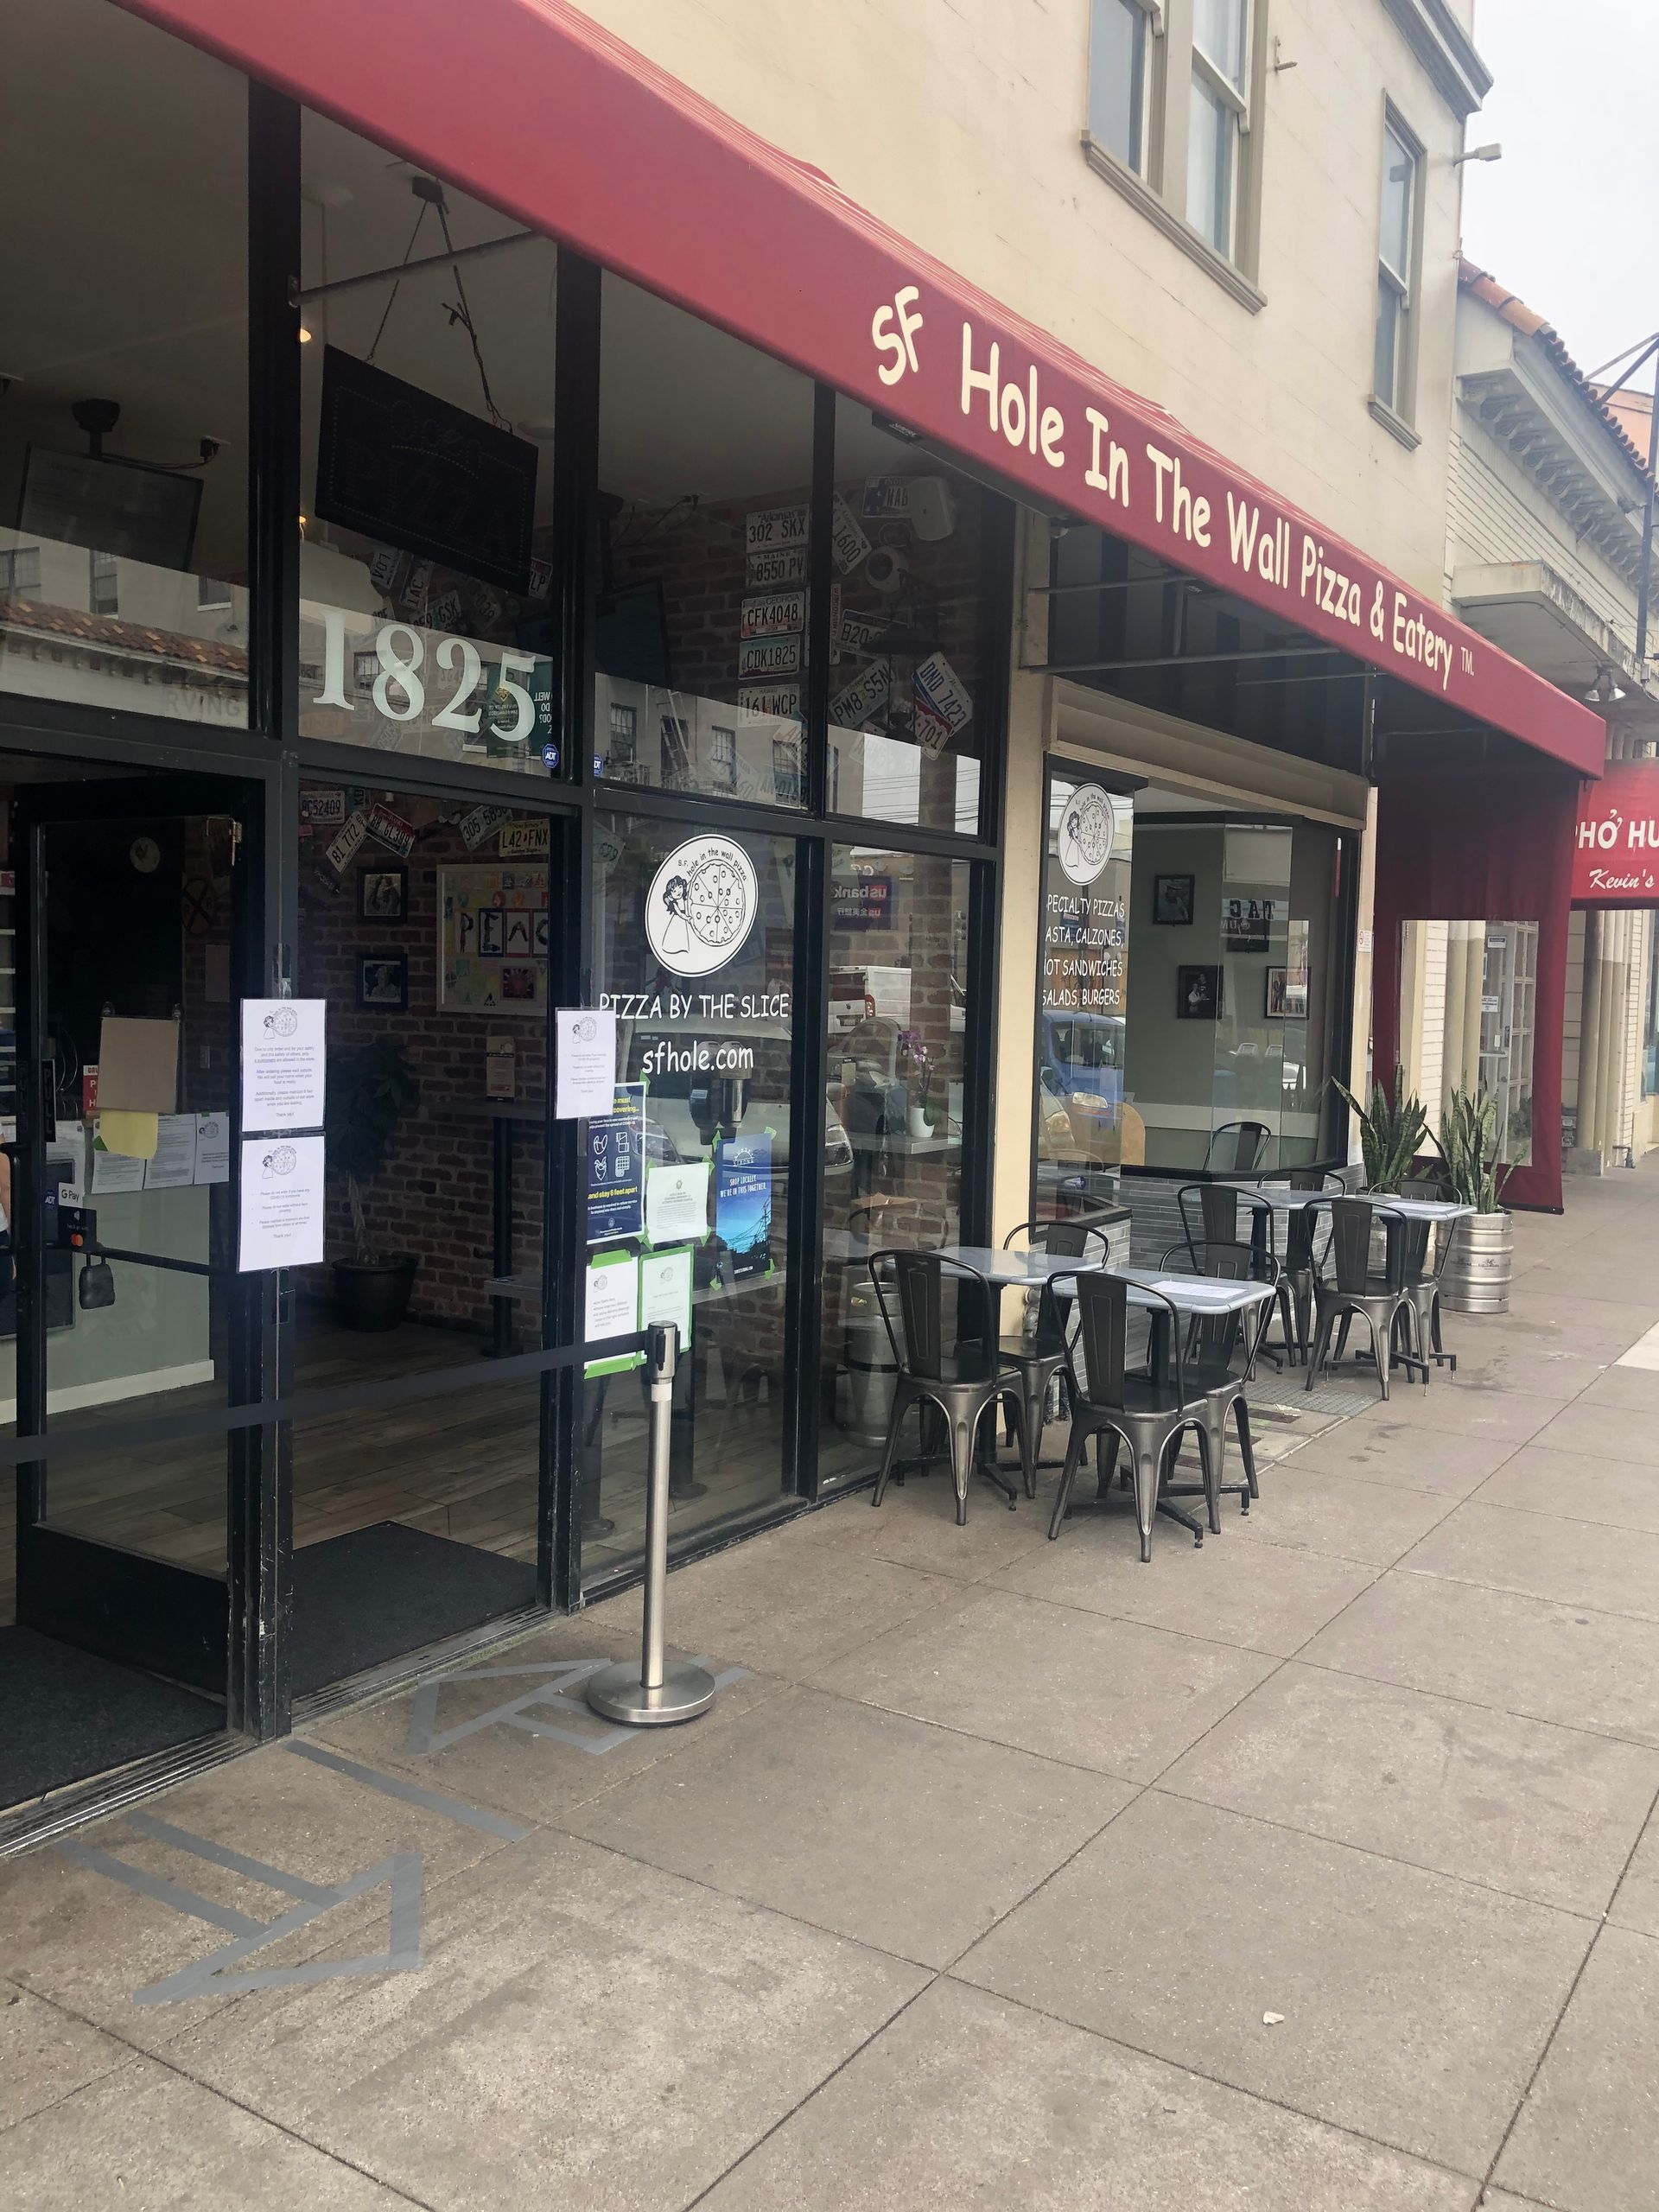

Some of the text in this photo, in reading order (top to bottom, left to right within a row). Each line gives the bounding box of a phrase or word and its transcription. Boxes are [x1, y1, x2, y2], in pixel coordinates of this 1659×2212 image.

[960, 322, 1065, 469] Hole
[1084, 406, 1130, 508] In
[1146, 444, 1211, 549] The
[1226, 491, 1291, 590] Wall
[1300, 535, 1362, 627] Pizza
[1370, 579, 1385, 640] &
[1392, 602, 1453, 690] Eatery
[749, 516, 805, 543] 302 SKX
[764, 549, 790, 560] MAINE
[756, 556, 804, 582] 8550 PV
[747, 603, 798, 627] CFK4048
[746, 644, 797, 670] CDK1825
[313, 608, 537, 742] 1825
[772, 693, 797, 715] WCP
[920, 662, 967, 728] DND 7423
[835, 690, 863, 726] PM8
[462, 818, 481, 842] 305
[527, 828, 549, 847] FNX
[1575, 809, 1624, 849] HỞ
[332, 845, 346, 864] 81
[677, 847, 747, 881] S.F. hole in the wall pizza
[1589, 868, 1656, 890] Kevin's
[1046, 893, 1126, 918] PECIALTY PIZZAS
[1045, 925, 1125, 950] ASTA, CALZONES,
[1062, 959, 1123, 977] SANDWICHES
[670, 995, 693, 1020] BY
[698, 994, 735, 1019] THE
[740, 993, 790, 1019] SLICE
[1081, 988, 1121, 1006] BURGERS
[642, 1039, 754, 1075] sfhole.com
[44, 1195, 56, 1205] ADT
[68, 1190, 79, 1203] Pay
[588, 1191, 599, 1199] and
[598, 1190, 610, 1199] stay
[624, 1185, 638, 1195] apart
[738, 1185, 747, 1195] THIS
